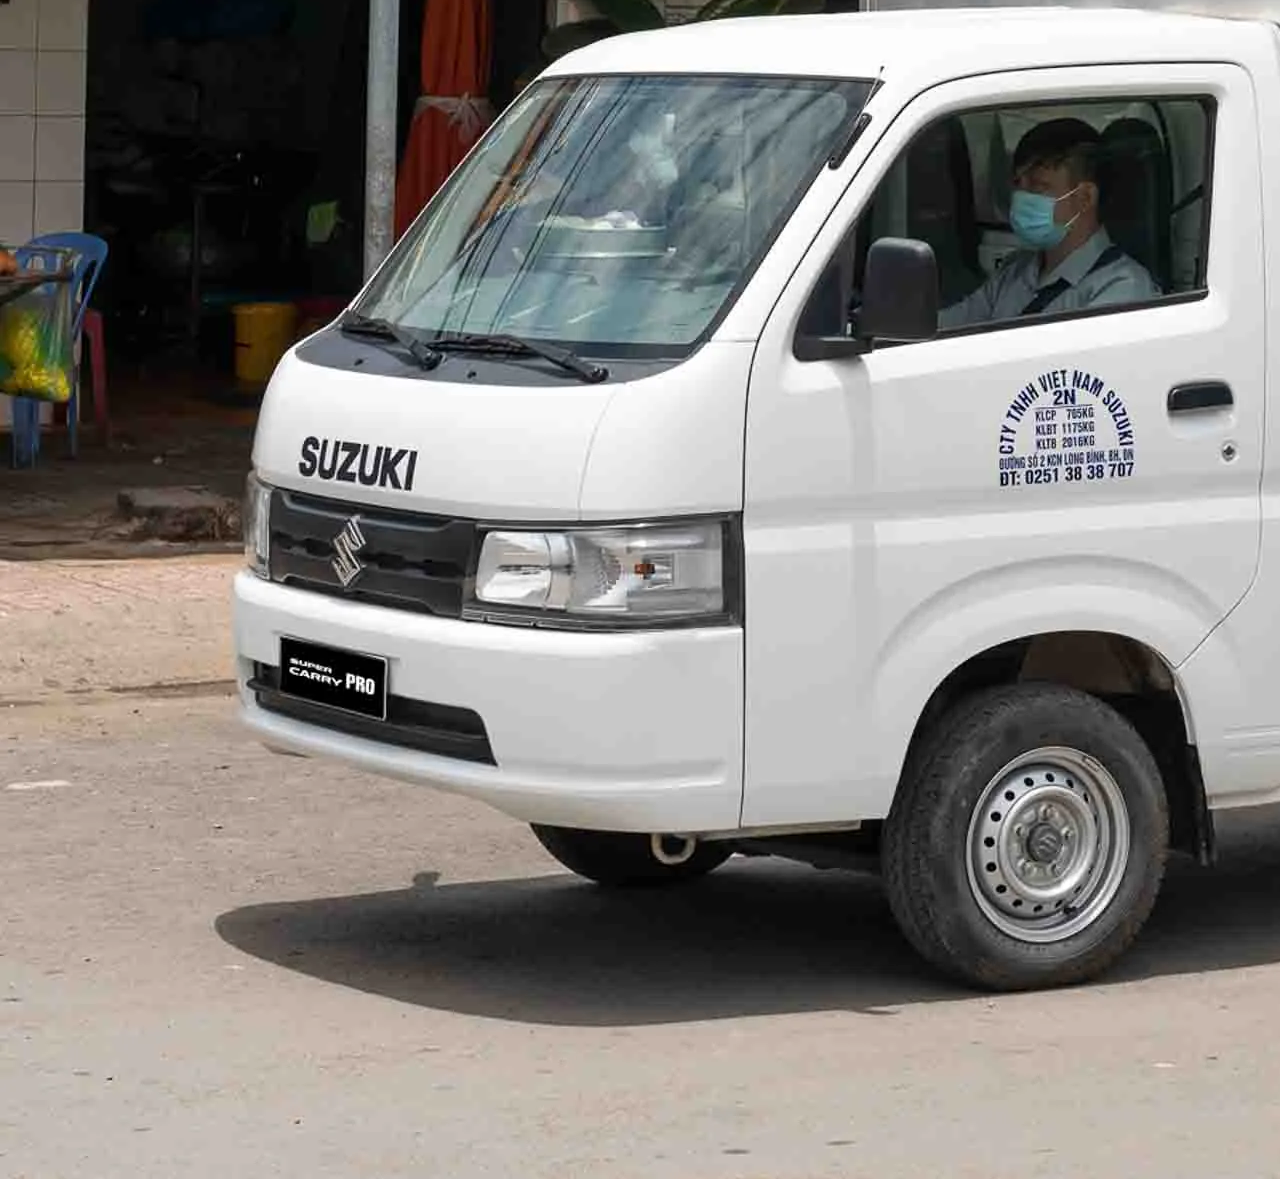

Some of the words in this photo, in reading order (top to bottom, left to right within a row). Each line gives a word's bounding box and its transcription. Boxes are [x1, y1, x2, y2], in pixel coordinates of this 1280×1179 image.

[1072, 369, 1105, 397] NAM
[1006, 383, 1039, 424] TNHH
[1053, 389, 1077, 406] 2N
[1102, 389, 1134, 447] SUZUKI
[999, 425, 1017, 454] CTY
[298, 434, 418, 492] SUZUKI
[1040, 454, 1046, 468] 2
[1000, 470, 1021, 487] ĐT:
[1025, 467, 1059, 485] 0251
[1064, 466, 1083, 482] 38
[1086, 464, 1105, 480] 38
[1108, 462, 1135, 478] 707
[288, 666, 343, 687] CARRY
[289, 657, 333, 675] SUPER
[345, 672, 376, 696] PRO
